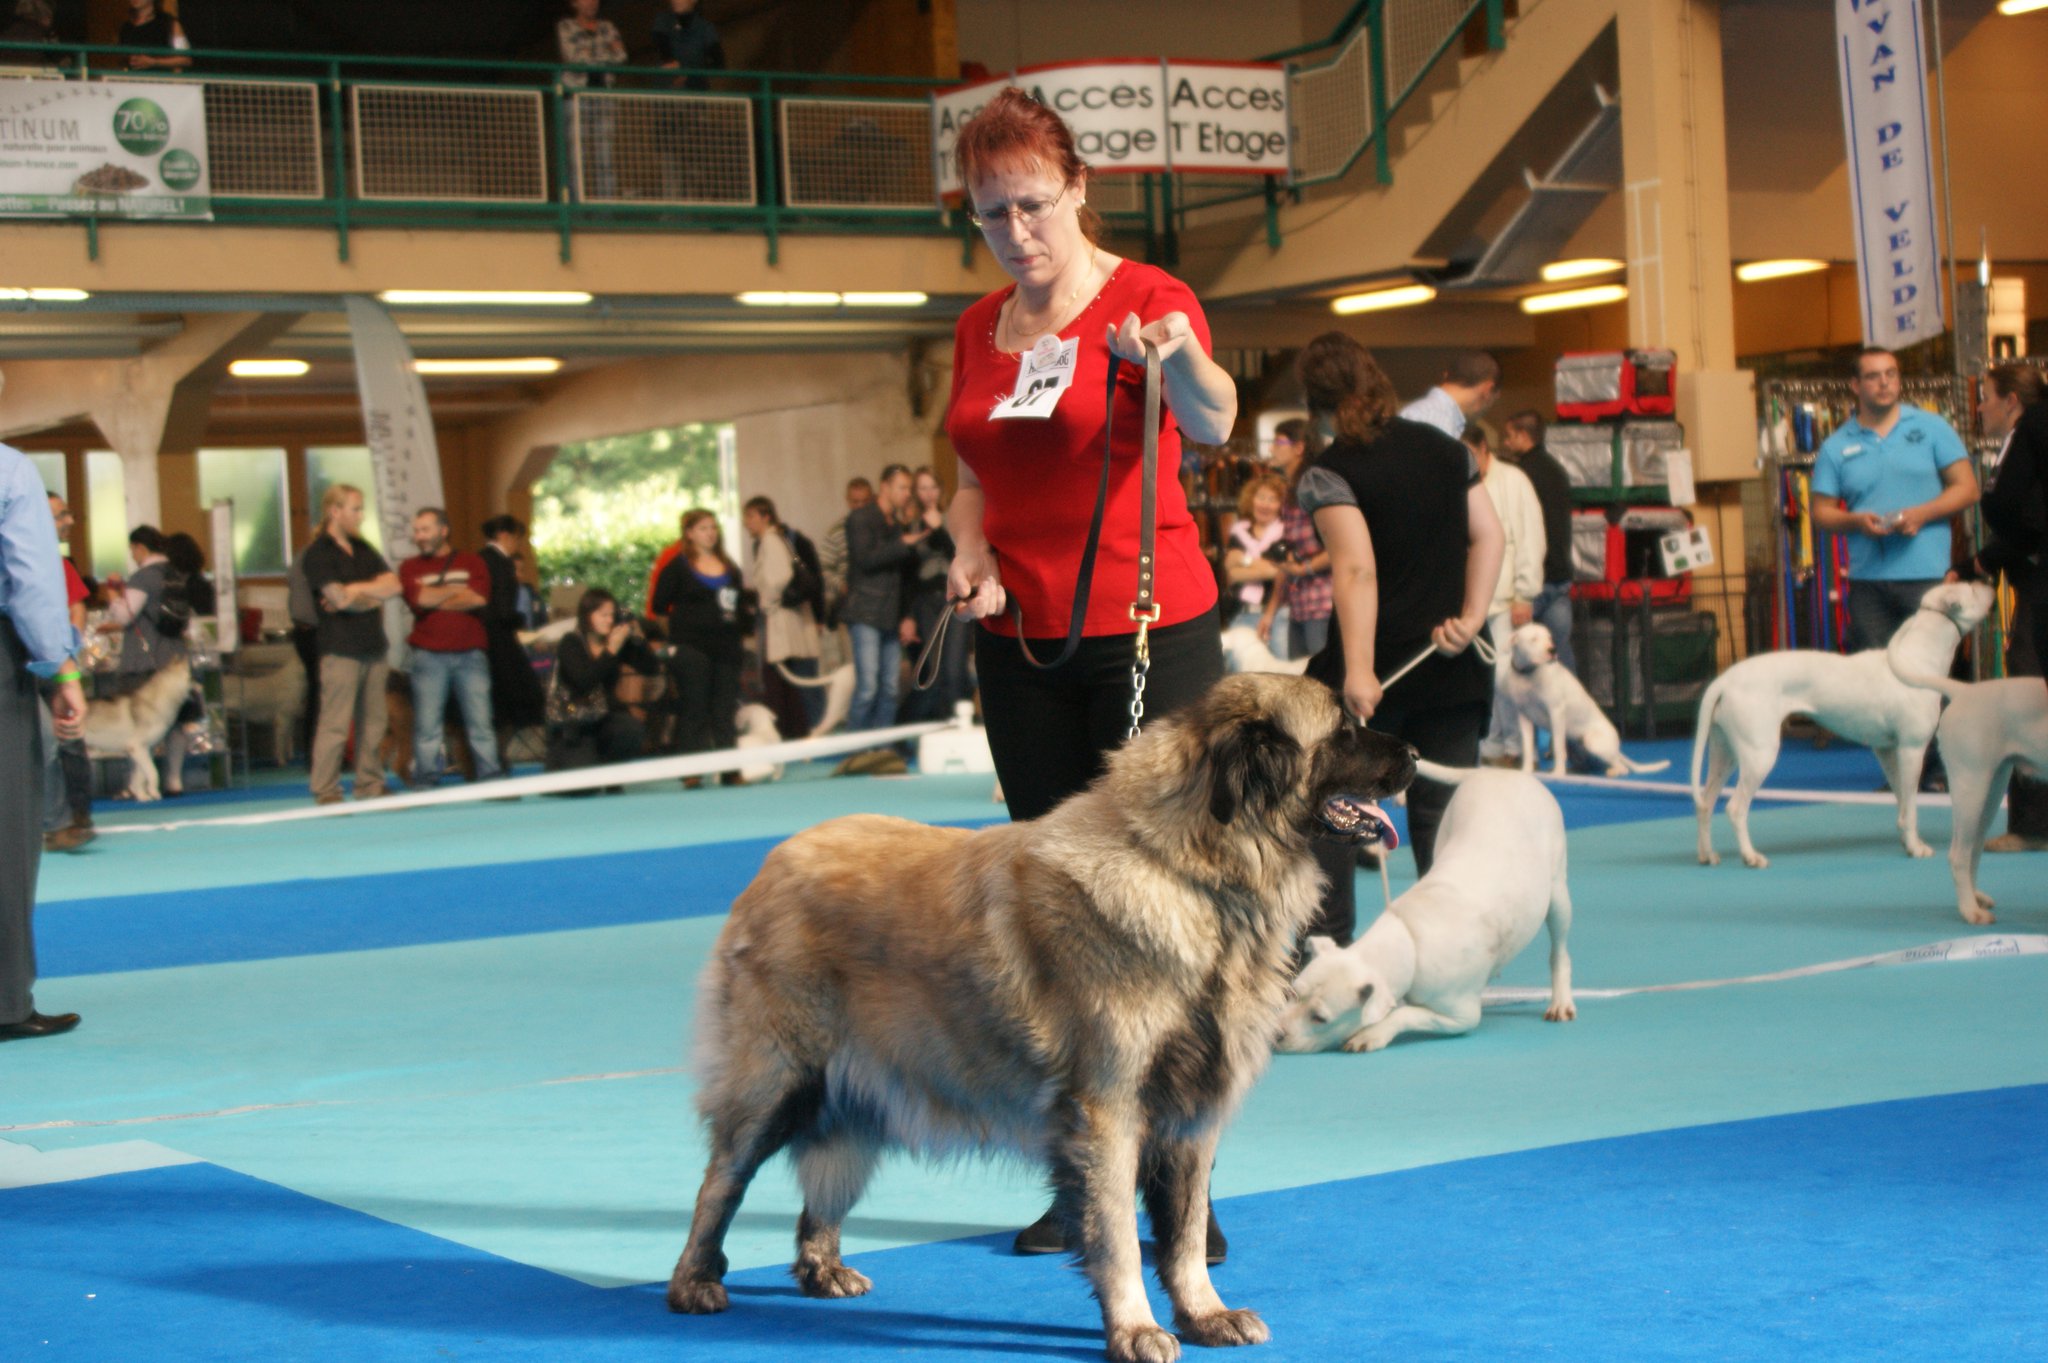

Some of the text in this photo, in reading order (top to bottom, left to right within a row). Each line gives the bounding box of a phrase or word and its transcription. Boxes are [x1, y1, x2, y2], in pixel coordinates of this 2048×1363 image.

[1199, 121, 1285, 161] Etage
[1867, 11, 1918, 333] VAN DE VELDE
